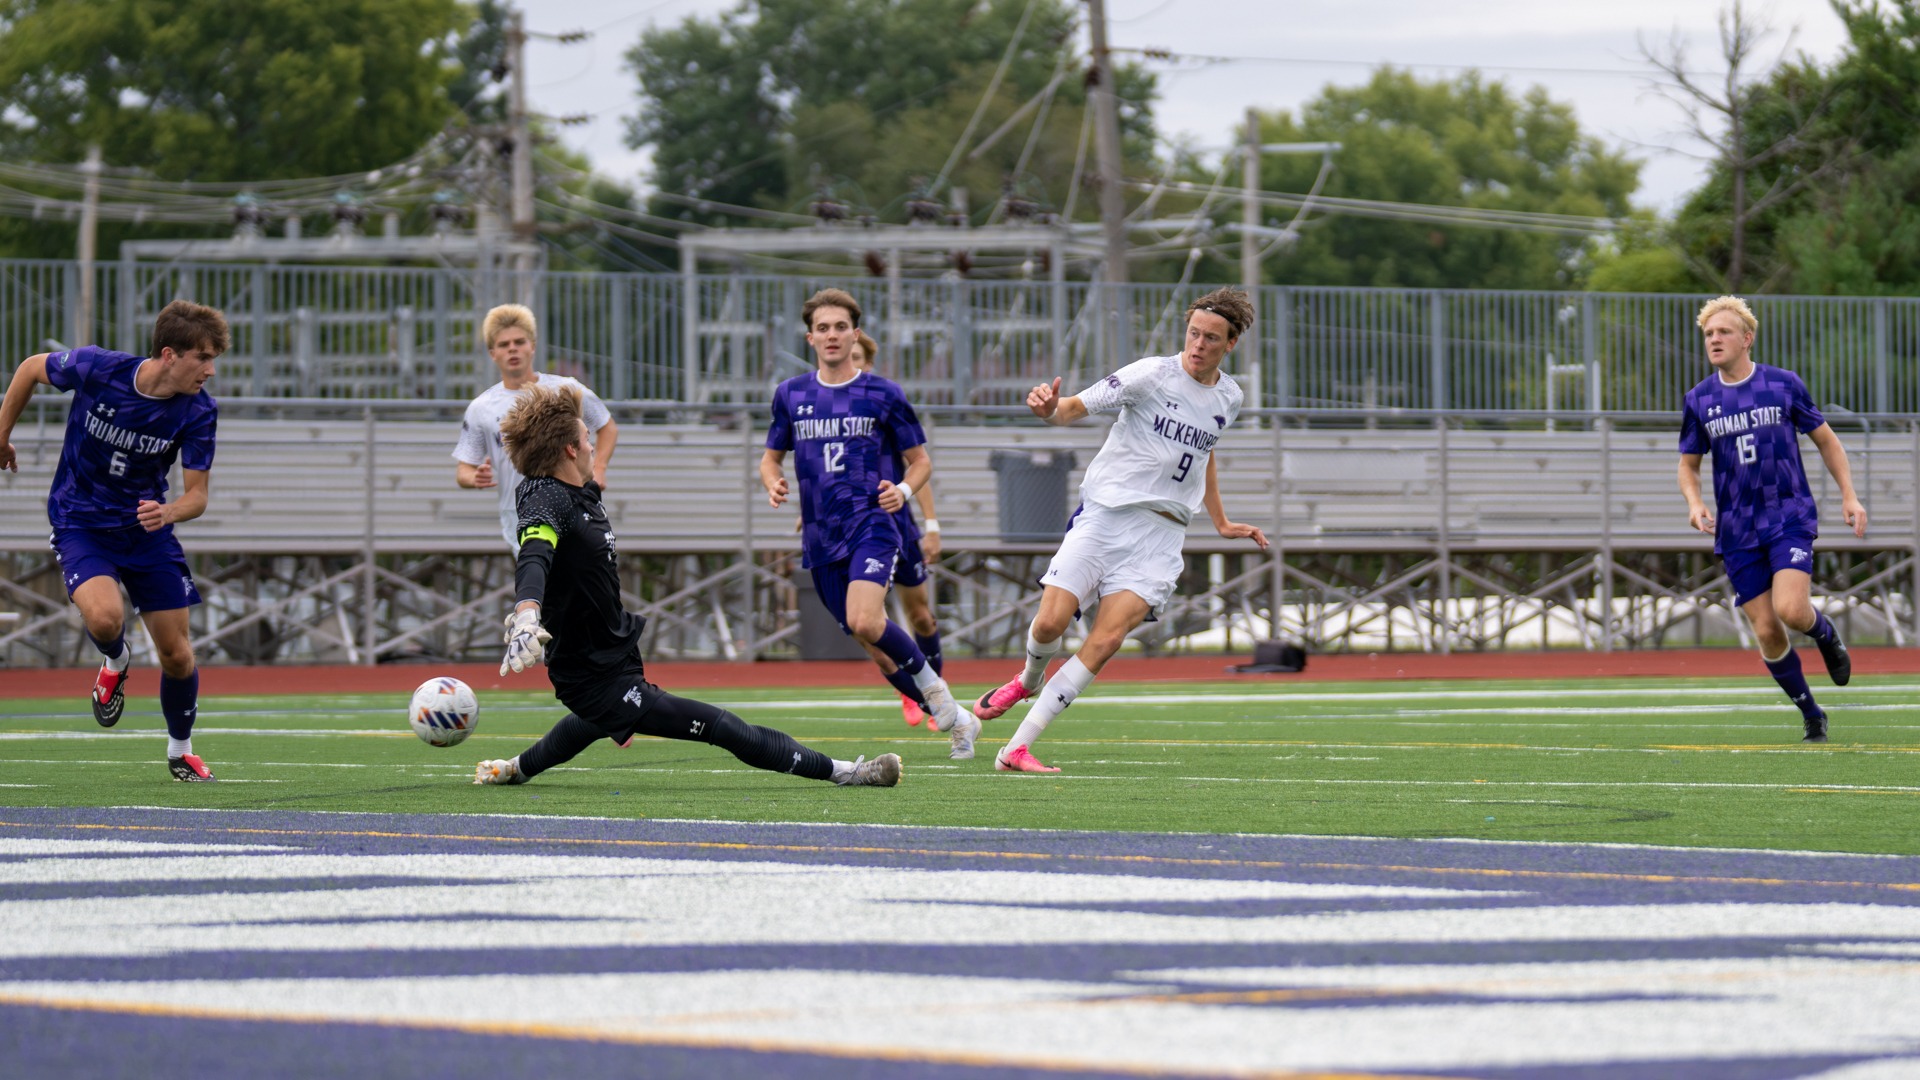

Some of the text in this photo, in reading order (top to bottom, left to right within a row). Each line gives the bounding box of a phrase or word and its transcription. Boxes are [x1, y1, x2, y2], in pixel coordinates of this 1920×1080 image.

[84, 410, 137, 450] TRUMAN
[793, 416, 876, 440] TRUMAN STATE
[1704, 406, 1783, 438] TRUMAN STATE
[108, 450, 128, 476] 6
[822, 442, 845, 473] 12
[1735, 433, 1758, 464] 15
[1171, 452, 1194, 483] 9
